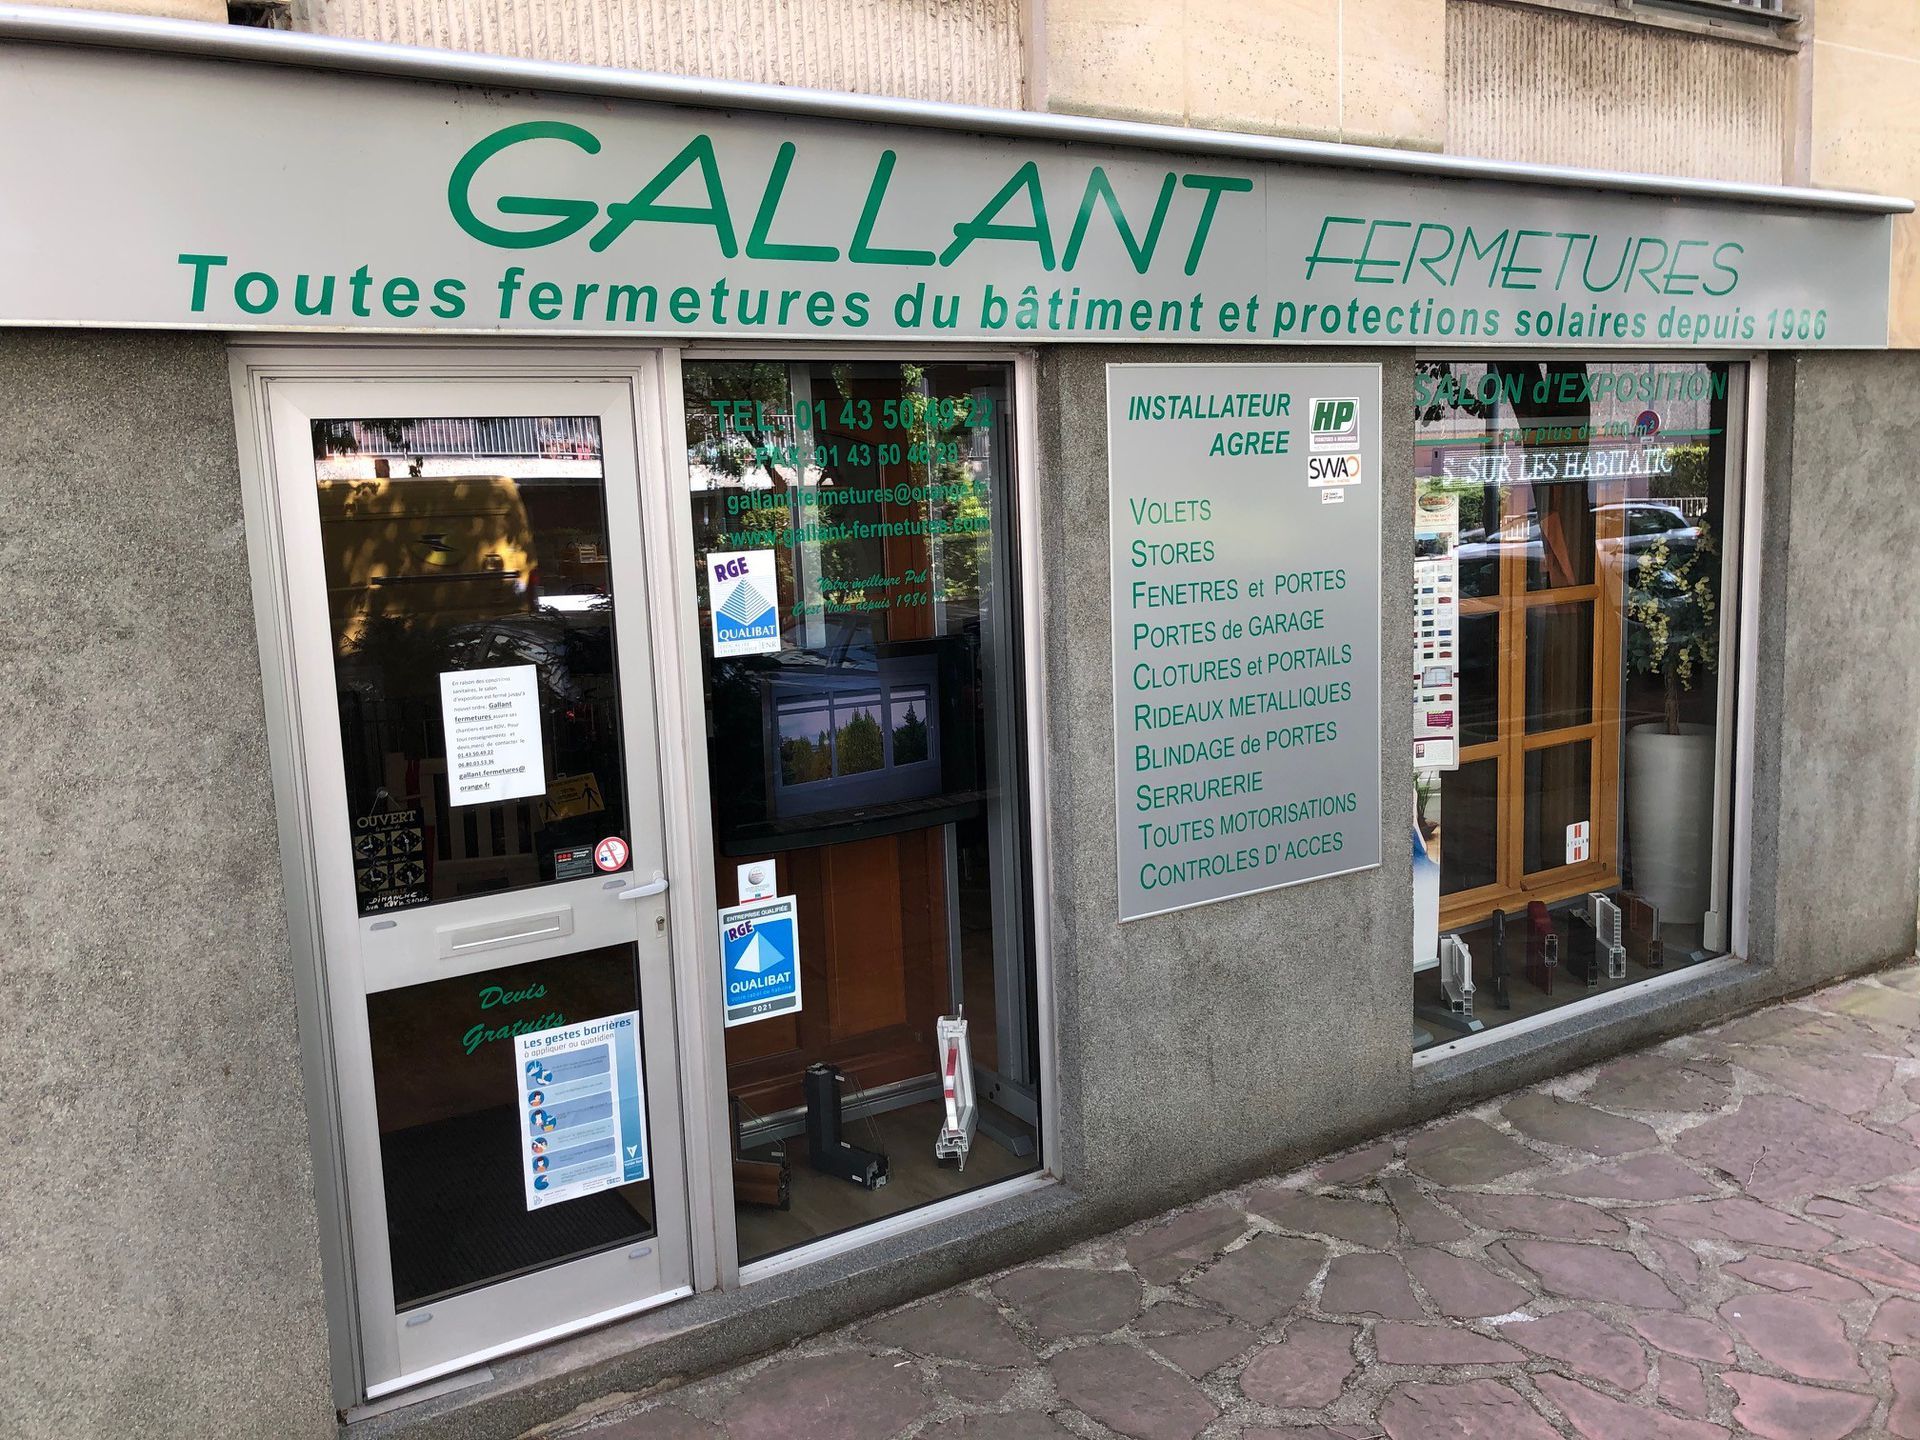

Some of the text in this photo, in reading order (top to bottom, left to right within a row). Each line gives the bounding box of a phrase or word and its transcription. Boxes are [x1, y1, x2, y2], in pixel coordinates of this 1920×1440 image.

[448, 121, 1253, 276] GALLANT
[1305, 216, 1744, 297] FERMETURES
[177, 253, 1827, 344] Toutes fermetures du bâtiment et protections solaires depuis 1986
[1415, 370, 1727, 406] SALON d'EXPOSITION
[796, 400, 827, 431] 01
[840, 399, 873, 430] 43
[883, 399, 914, 429] 50
[924, 398, 955, 429] 49
[964, 396, 993, 428] 22
[1128, 393, 1291, 421] INSTALLATEUR
[1313, 401, 1355, 431] HP
[1209, 430, 1290, 457] AGREE
[1502, 427, 1531, 442] sur
[1535, 423, 1572, 443] plus
[1578, 422, 1598, 439] de
[1603, 421, 1631, 439] 100
[815, 445, 839, 468] 01
[847, 444, 871, 467] 43
[878, 443, 901, 465] 50
[1467, 455, 1514, 484] SUR
[1519, 453, 1558, 481] LES
[1130, 498, 1211, 525] VOLETS
[730, 516, 990, 549] www.gallant-fermetures.com
[1131, 539, 1215, 567] STORES
[714, 557, 749, 582] RGE
[904, 568, 928, 583] Pub
[856, 598, 892, 614] depuis
[896, 592, 927, 608] 1986
[1132, 569, 1346, 609] FENETRES et PORTES
[720, 625, 776, 641] QUALIBAT
[1134, 609, 1324, 650] PORTES de GARAGE
[1133, 644, 1352, 690] CLOTURES et PORTAILS
[454, 713, 492, 724] fermetures
[488, 700, 513, 710] Gallant
[1135, 681, 1352, 731] RIDEAUX METALLIQUES
[1135, 721, 1337, 771] BLINDAGE de PORTES
[460, 781, 490, 792] orange.fr
[1136, 771, 1263, 811] SERRURERIE
[357, 809, 416, 829] OUVERT
[1138, 792, 1357, 850] TOUTES MOTORISATIONS
[1140, 848, 1259, 889] CONTROLES
[726, 909, 761, 923] ENTREPRISE
[728, 920, 754, 941] RGE
[479, 982, 548, 1010] Devis
[730, 971, 791, 994] QUALIBAT
[752, 1003, 772, 1014] 2021
[462, 1011, 566, 1055] Gratuits
[524, 1018, 631, 1049] Les gestes barrières
[531, 1042, 566, 1057] appliquer
[580, 1032, 614, 1047] quotidien
